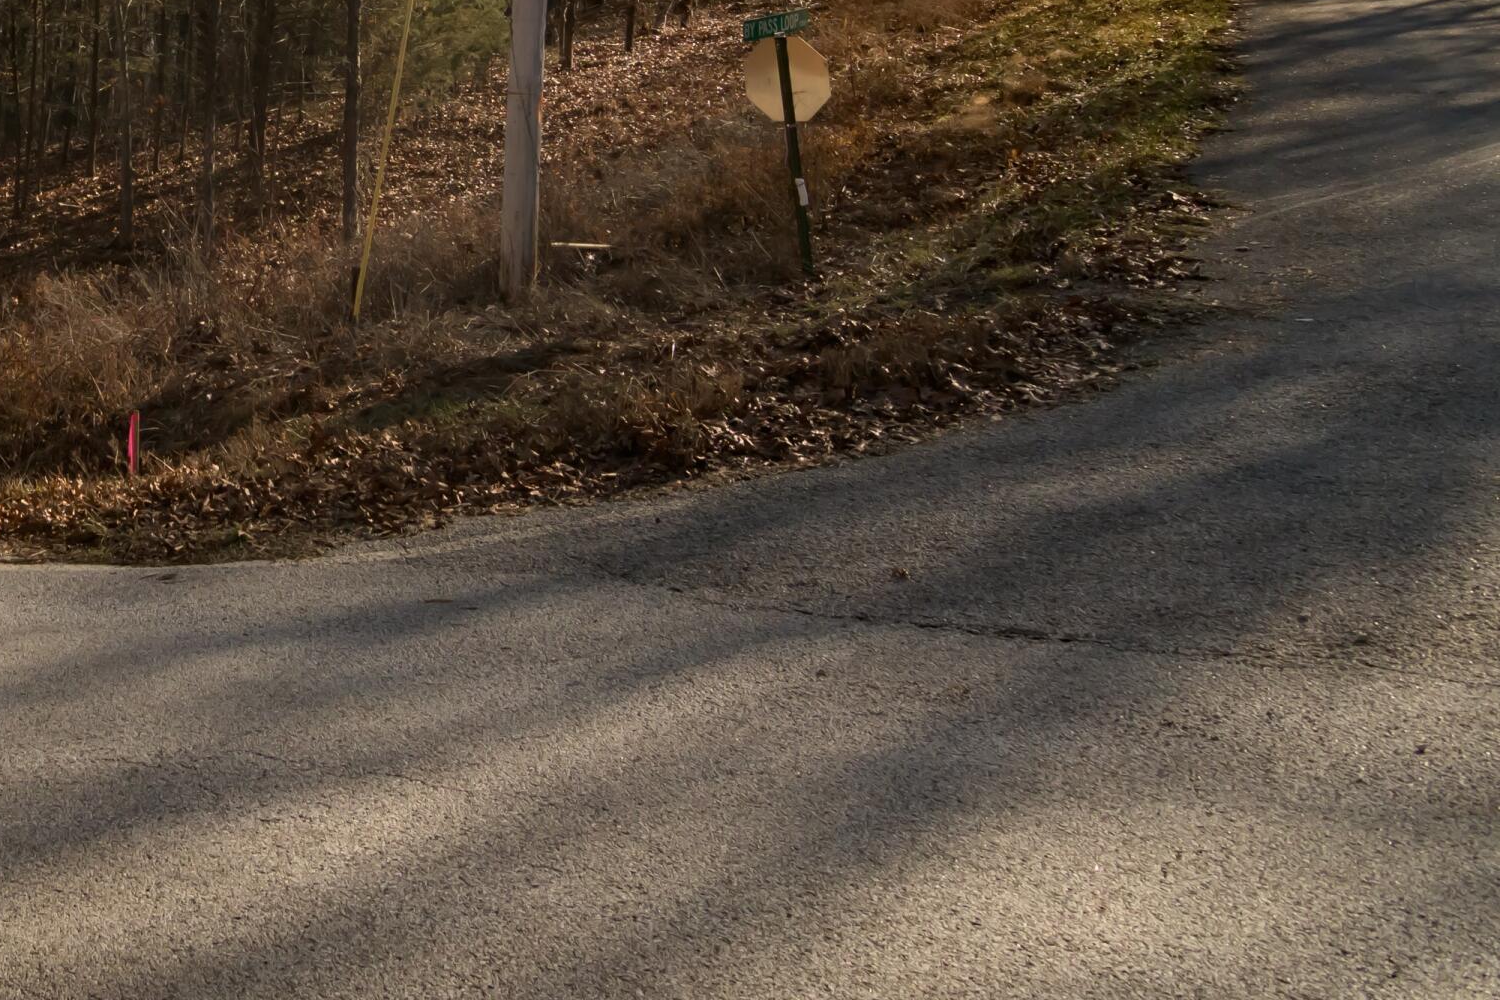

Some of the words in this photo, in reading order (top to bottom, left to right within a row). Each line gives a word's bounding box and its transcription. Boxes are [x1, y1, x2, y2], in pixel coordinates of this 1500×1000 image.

[744, 22, 755, 39] BY
[758, 18, 778, 37] PASS
[780, 13, 799, 31] LOOP
